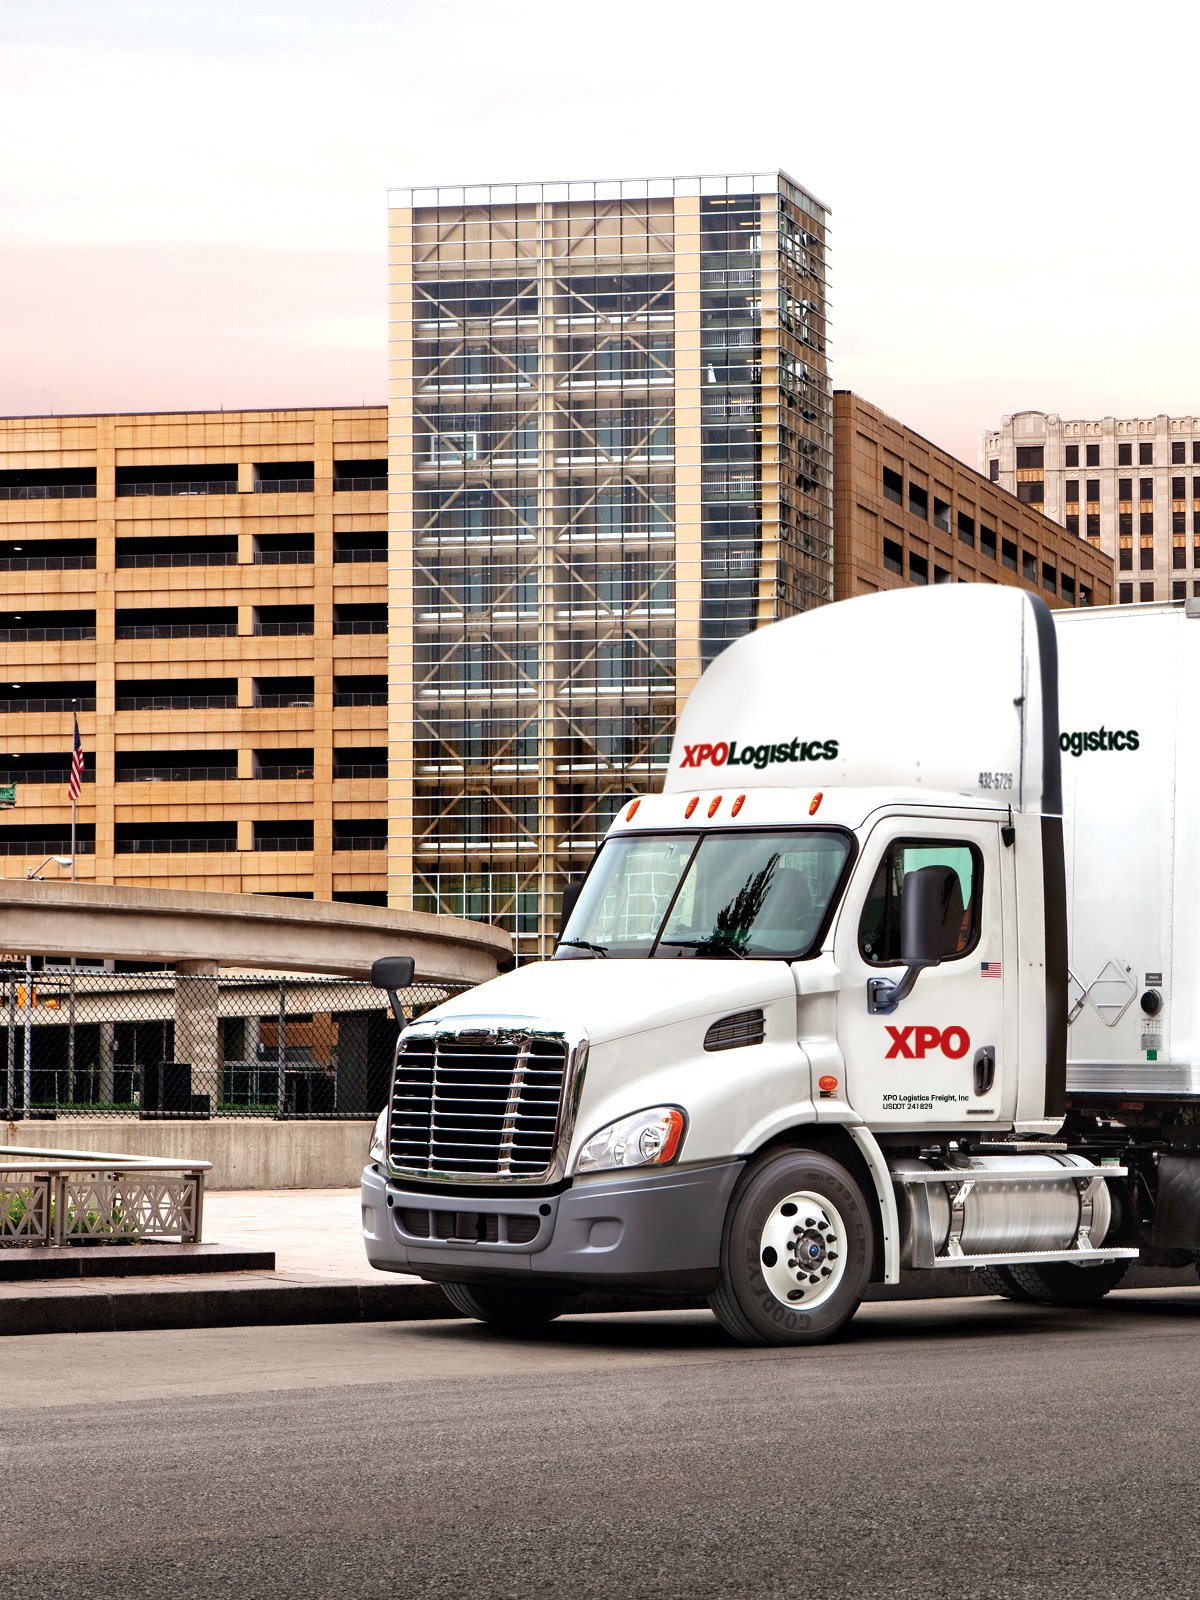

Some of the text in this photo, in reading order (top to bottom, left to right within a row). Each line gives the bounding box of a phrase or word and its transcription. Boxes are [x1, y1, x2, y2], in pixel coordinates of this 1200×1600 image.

[978, 772, 1013, 789] 432-5726
[884, 1025, 970, 1060] XPO
[882, 1094, 970, 1103] XPO Logistics Freight, Inc
